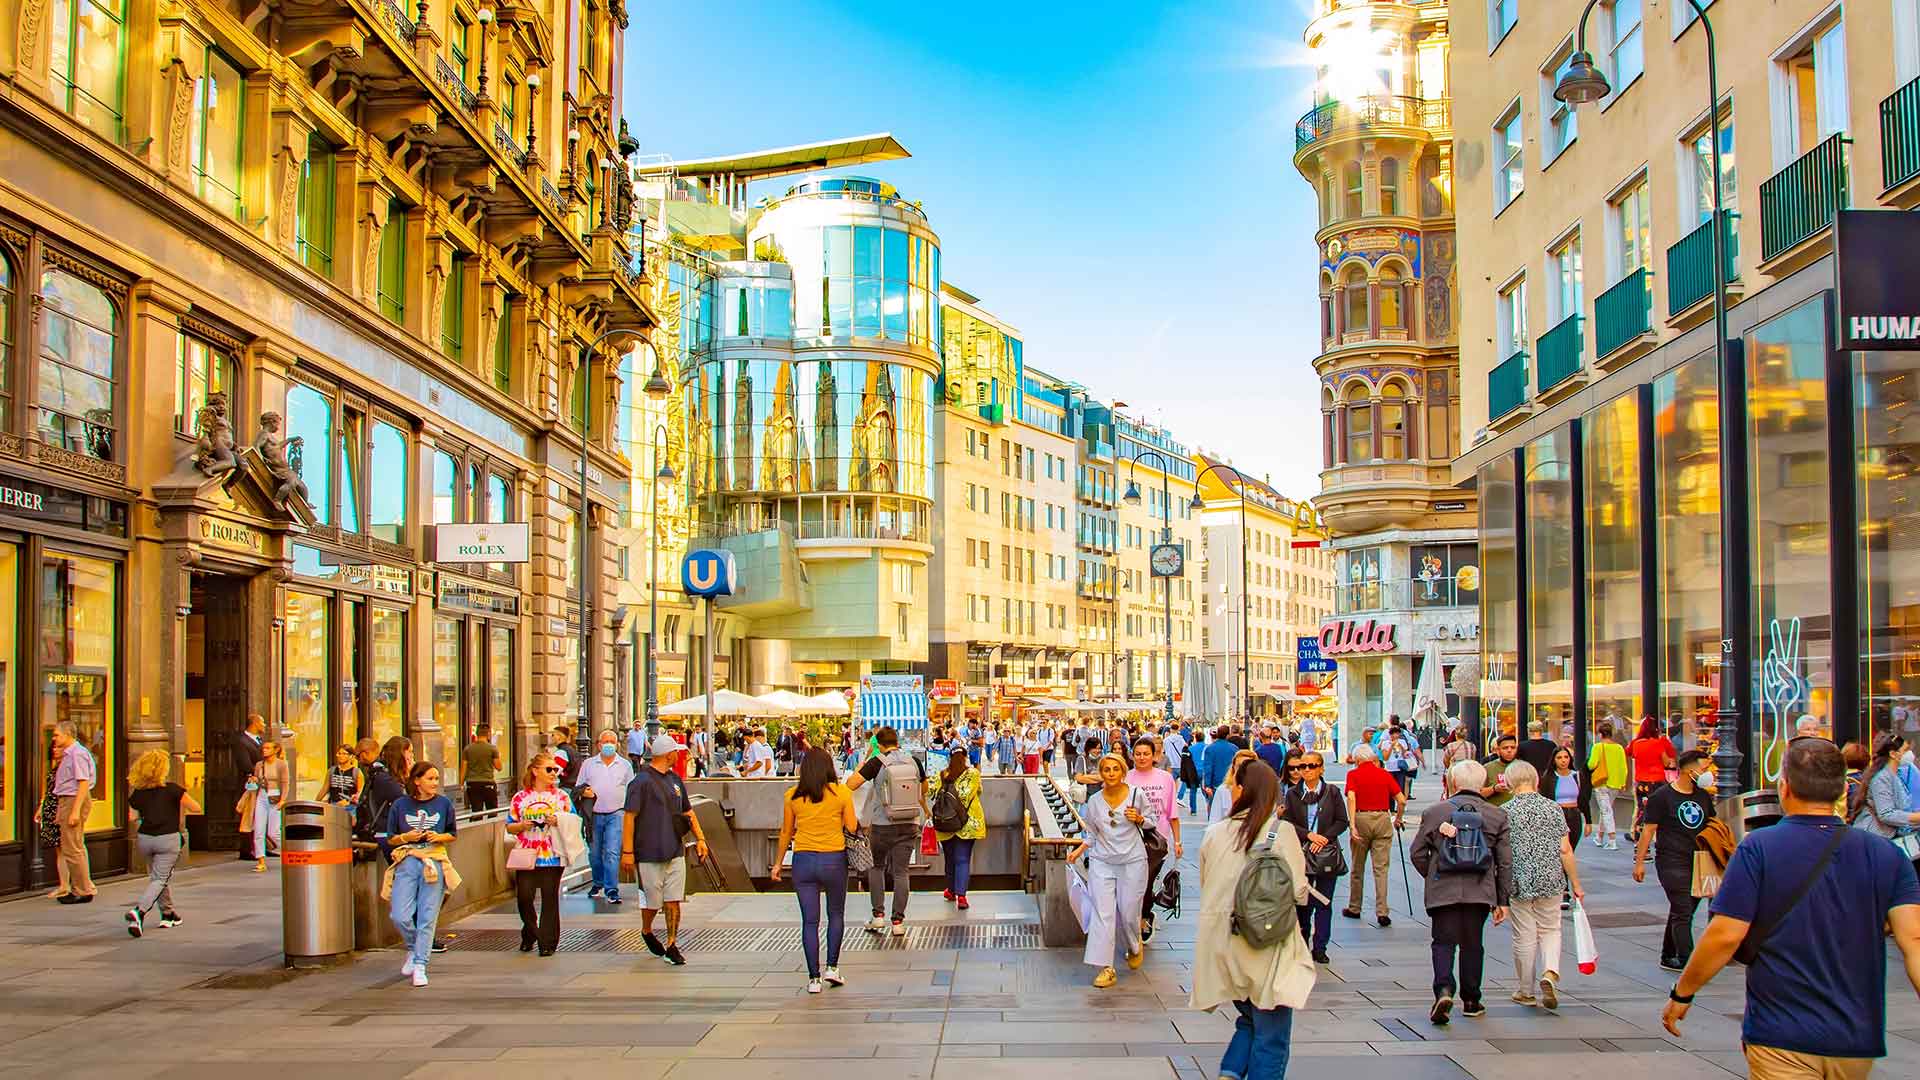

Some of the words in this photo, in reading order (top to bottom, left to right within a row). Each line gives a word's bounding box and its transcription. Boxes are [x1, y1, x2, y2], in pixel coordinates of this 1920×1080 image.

[211, 523, 250, 545] ROLEX
[458, 545, 505, 555] ROLEX
[689, 559, 717, 589] U
